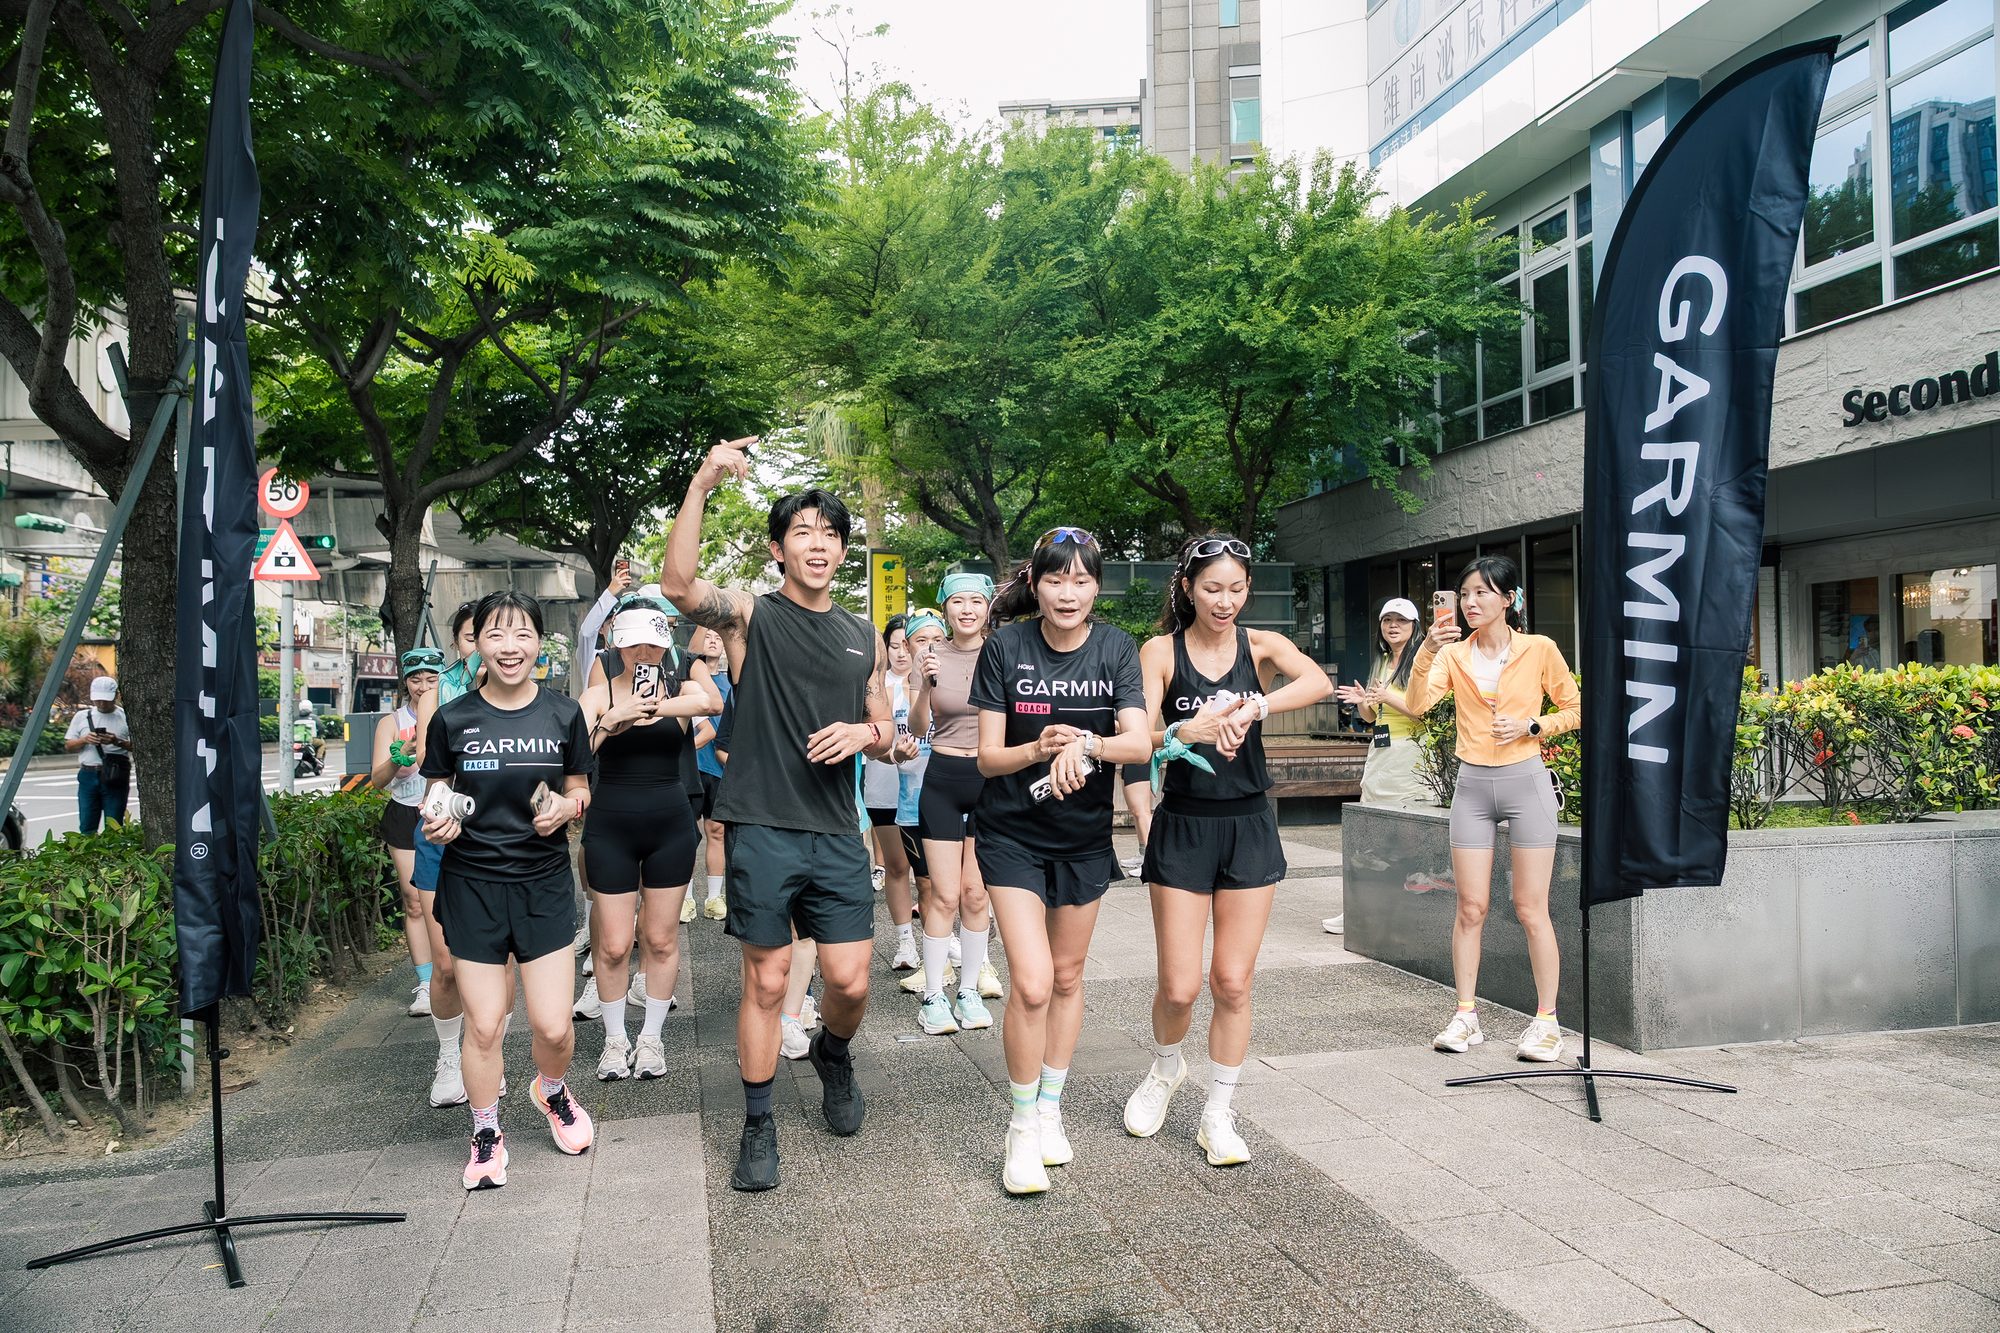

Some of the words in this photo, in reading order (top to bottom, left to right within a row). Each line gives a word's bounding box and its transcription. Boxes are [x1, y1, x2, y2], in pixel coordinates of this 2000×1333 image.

[1384, 0, 1546, 129] 維尚泌尿科
[1842, 350, 2000, 428] Second
[269, 483, 299, 502] 50
[1623, 255, 1728, 764] GARMIN
[1016, 679, 1114, 697] GARMIN
[1018, 703, 1048, 713] COACH
[463, 738, 561, 755] GARMIN
[465, 761, 496, 770] PACER
